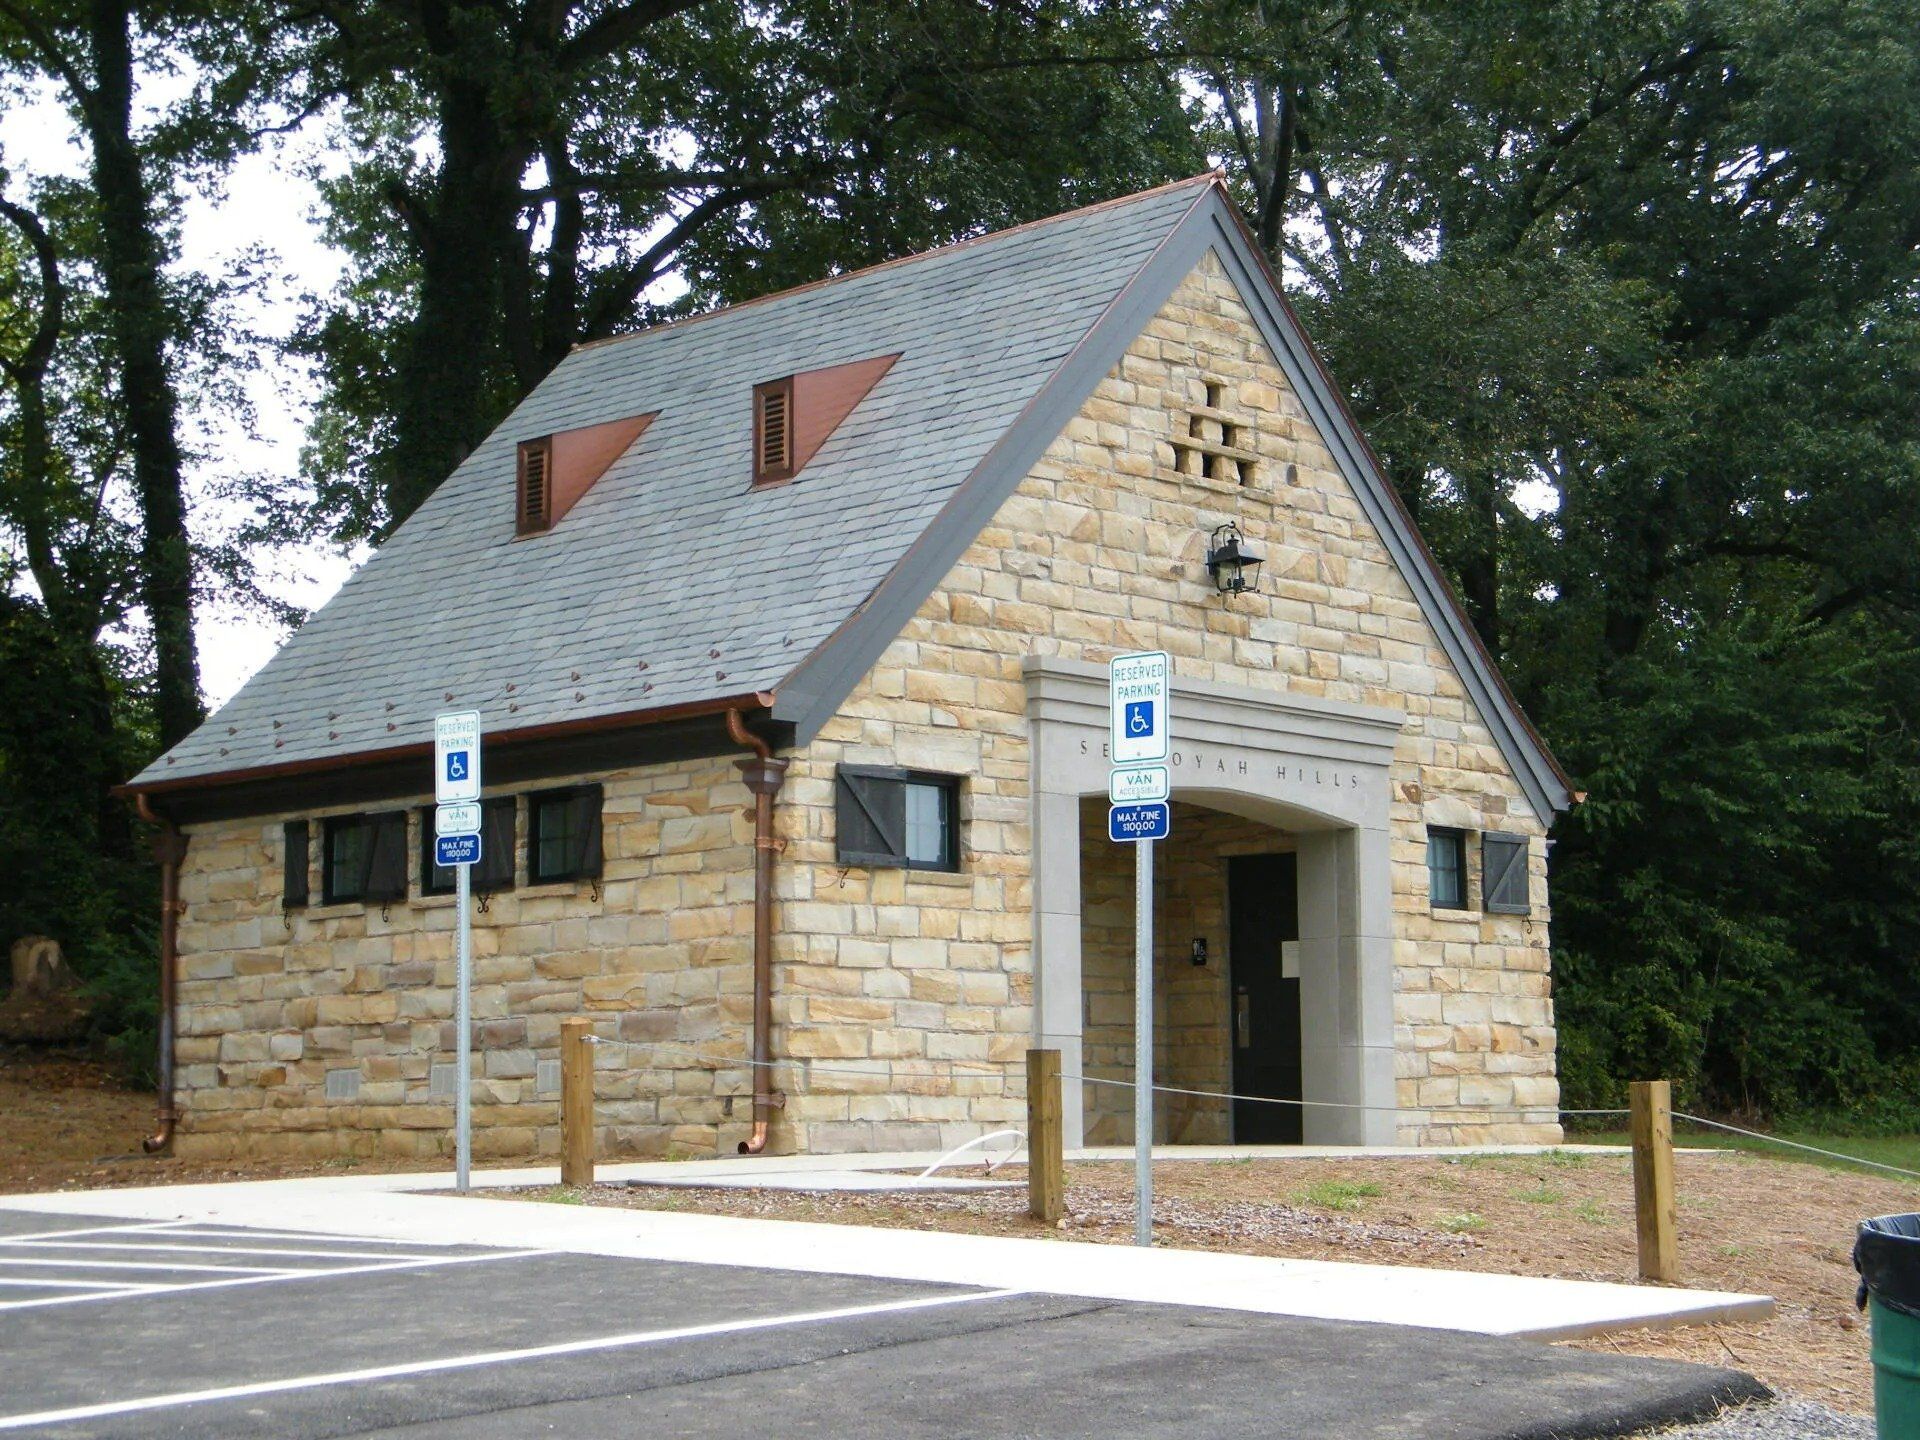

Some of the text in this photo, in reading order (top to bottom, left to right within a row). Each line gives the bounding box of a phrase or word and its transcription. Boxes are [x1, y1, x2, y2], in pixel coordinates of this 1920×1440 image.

[1114, 664, 1164, 681] RESERVED
[1118, 682, 1161, 699] PARKING
[439, 720, 476, 735] RESERVED
[441, 736, 474, 748] PARKING
[1080, 740, 1248, 775] SEOYAH
[1126, 774, 1153, 785] VAN
[1276, 765, 1358, 789] HILLS
[448, 811, 469, 820] VAN
[1117, 810, 1161, 823] MAX FINE
[1122, 820, 1156, 832] $100.00
[441, 840, 475, 850] MAX FINE
